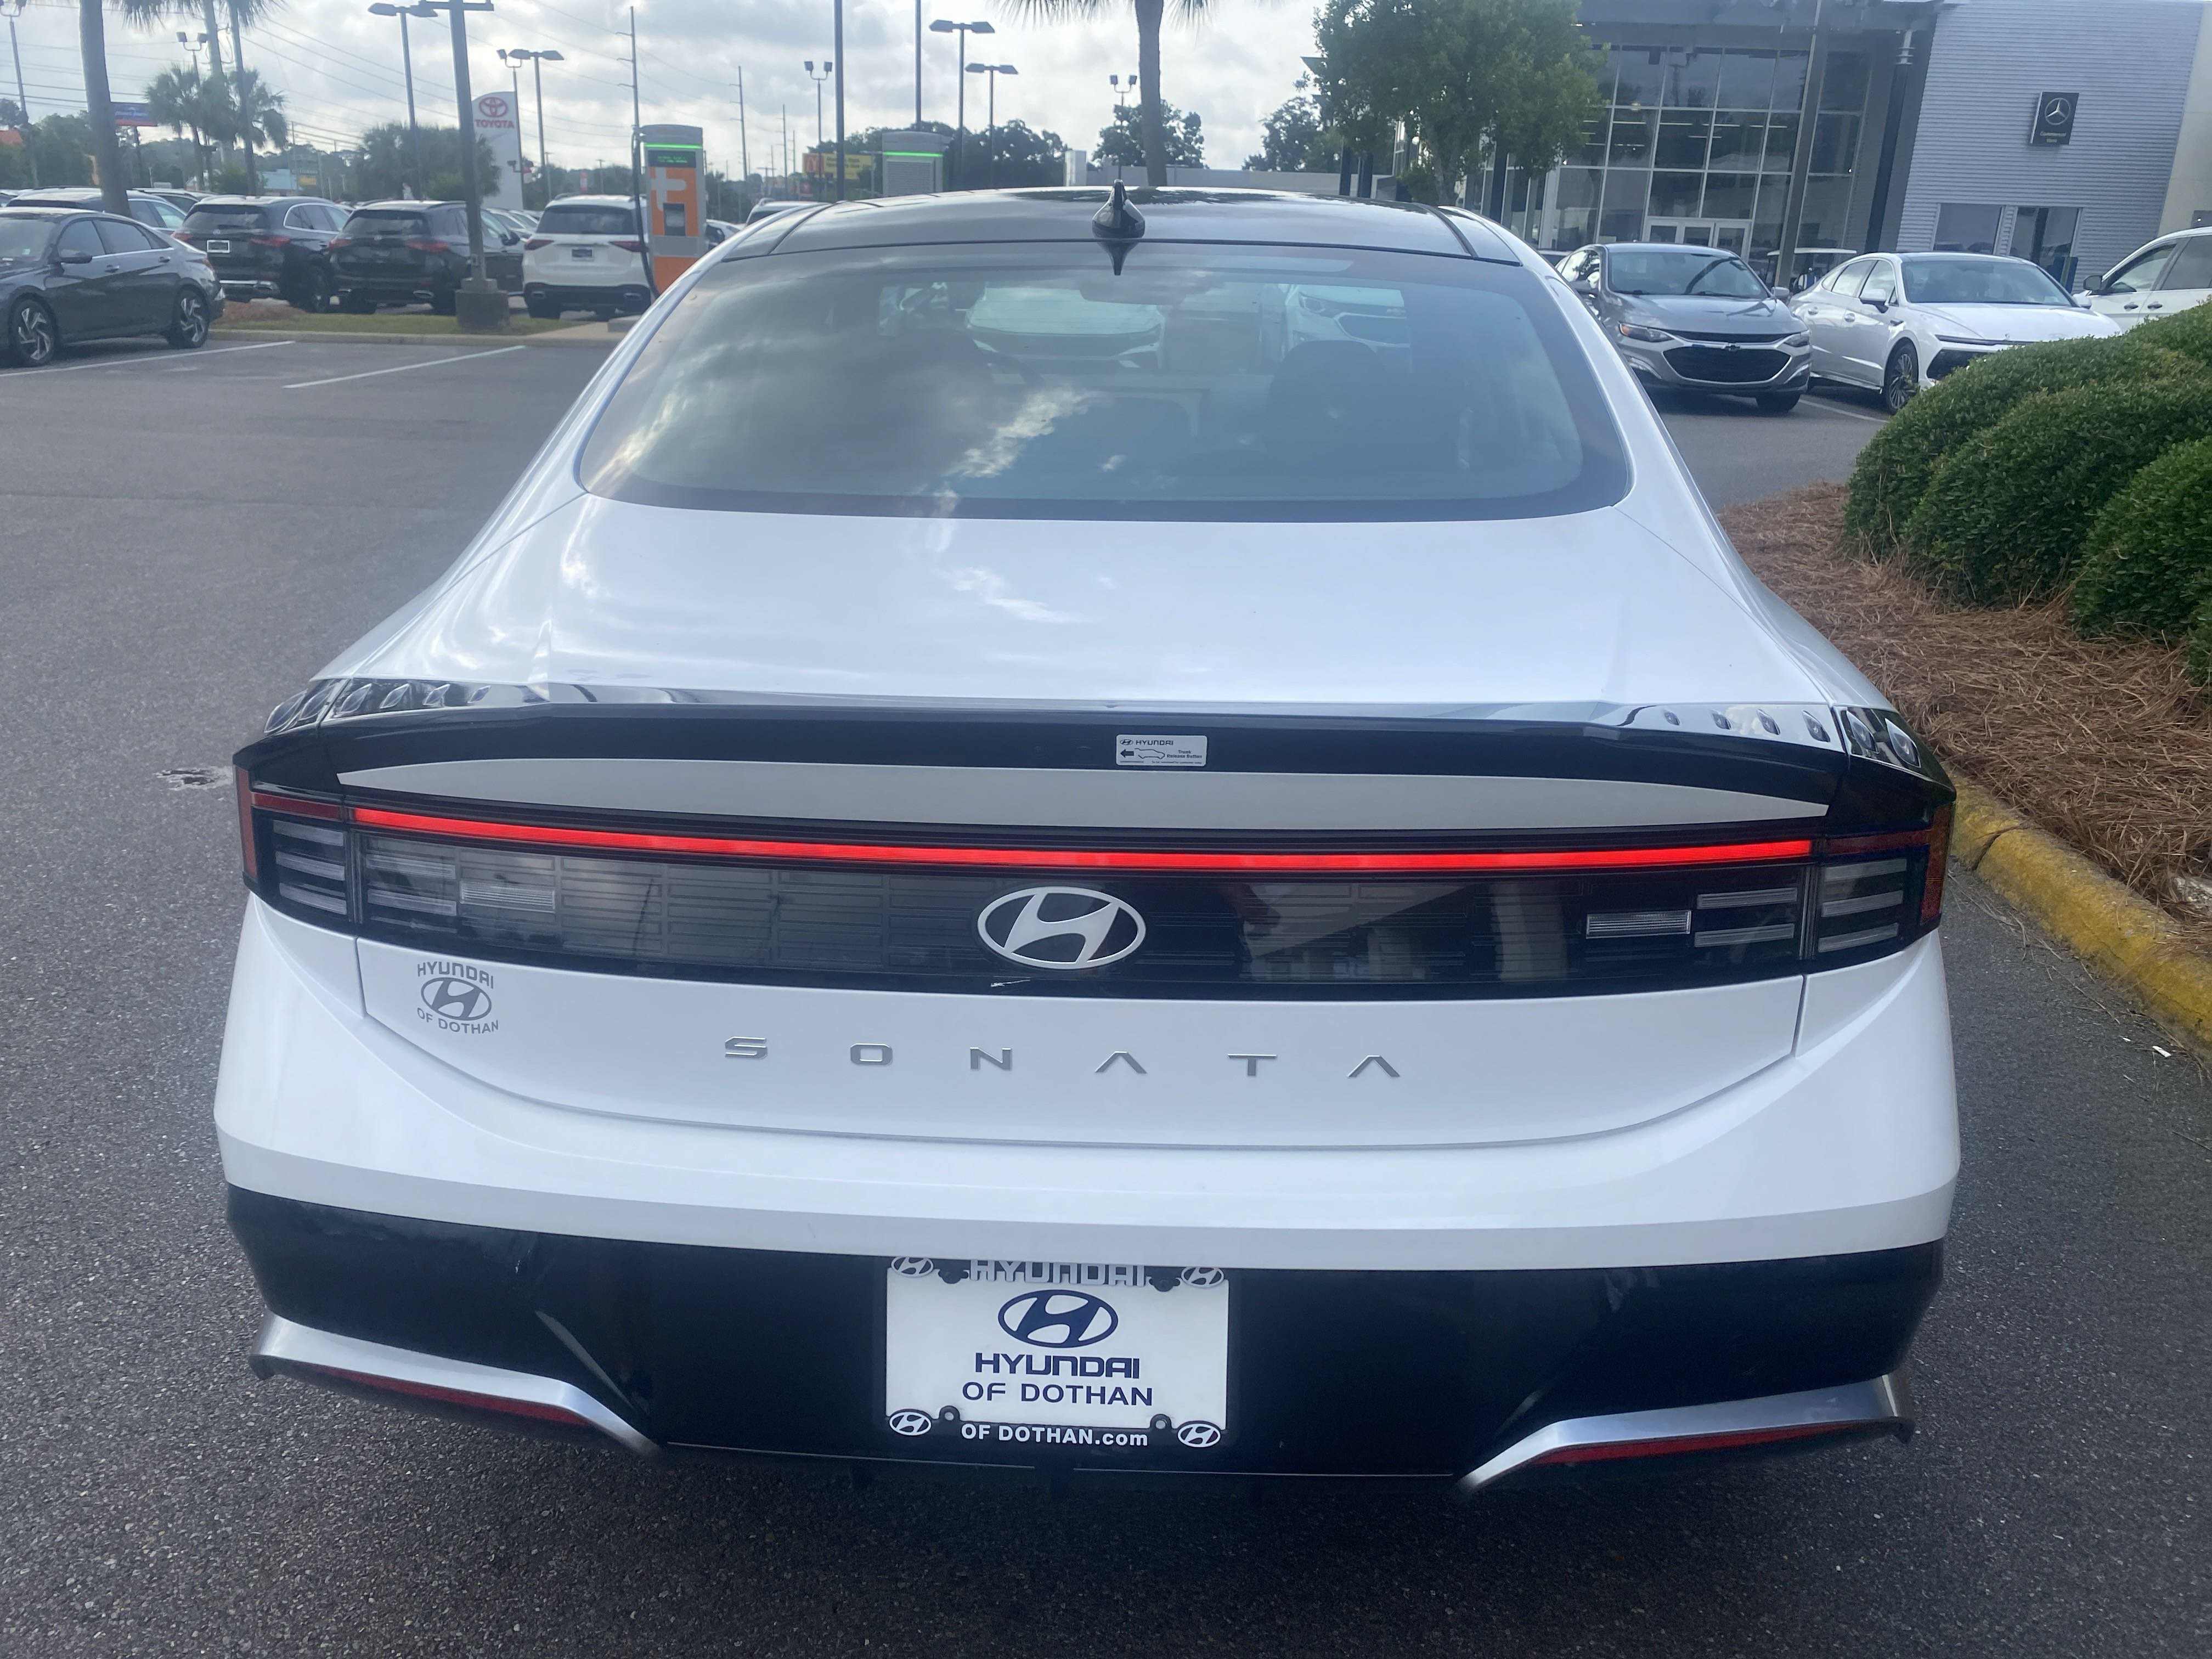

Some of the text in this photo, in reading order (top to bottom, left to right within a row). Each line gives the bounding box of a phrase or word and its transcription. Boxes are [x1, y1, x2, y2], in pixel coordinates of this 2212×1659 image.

[474, 119, 515, 128] TOYOTA
[417, 961, 494, 989] HYUNDAI
[417, 1007, 499, 1034] OF DOTHAN
[725, 1036, 1400, 1079] SONATA
[969, 1259, 1145, 1287] HYUNDAI
[975, 1352, 1140, 1379] HYUNDAI
[962, 1381, 1153, 1406] OF DOTHAN
[961, 1423, 1148, 1447] OF DOTHAN.com
